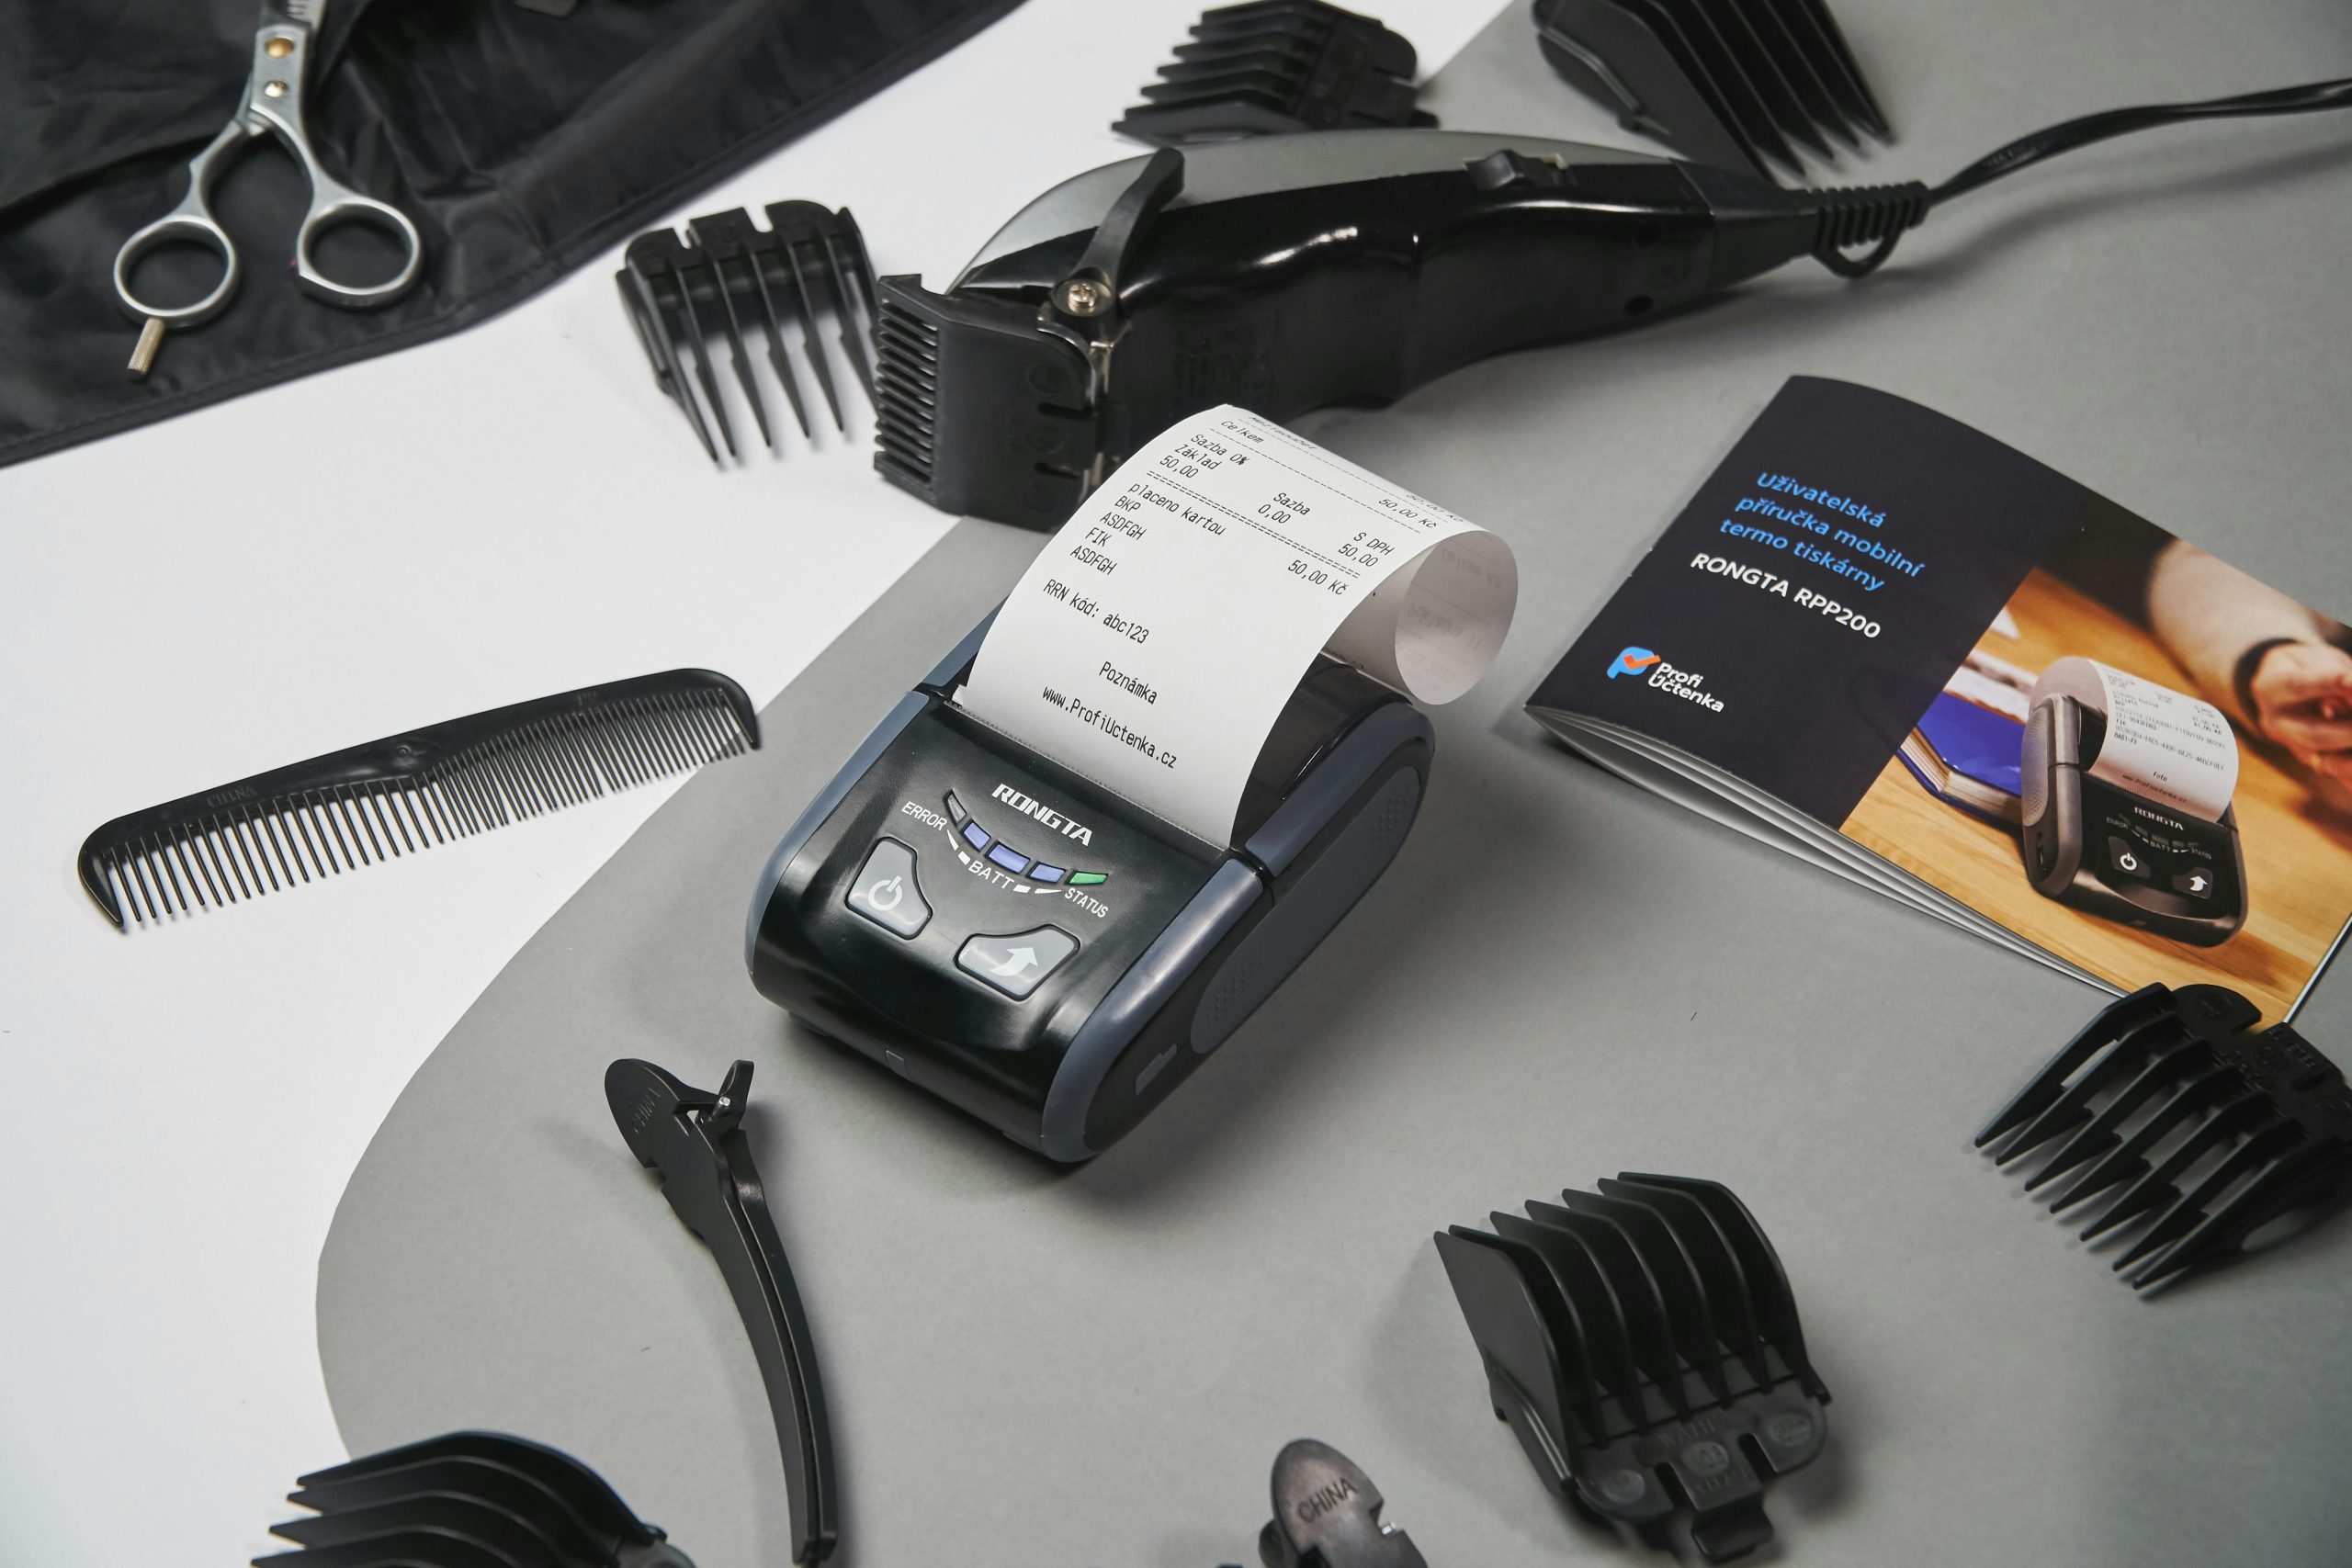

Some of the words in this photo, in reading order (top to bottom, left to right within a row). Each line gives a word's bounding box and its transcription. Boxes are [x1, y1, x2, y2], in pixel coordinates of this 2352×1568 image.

[1191, 433, 1227, 457] Sazba
[1229, 453, 1250, 466] 0%
[1220, 420, 1264, 444] Celkem
[1378, 498, 1418, 518] 50,00
[1419, 518, 1438, 528] Kč
[1114, 495, 1142, 513] BKP
[1159, 456, 1199, 479] 50,00
[1257, 503, 1292, 525] 0,00
[1338, 543, 1379, 568] 50,00
[1173, 444, 1220, 470] Základ
[1272, 492, 1311, 515] Sazba
[1353, 531, 1367, 543] S
[1365, 537, 1396, 557] DPH
[1757, 472, 1887, 528] Uživatelská
[1085, 527, 1113, 547] FIK
[1099, 512, 1148, 540] ASDFGH
[1127, 482, 1180, 513] placeno
[1181, 507, 1227, 536] kartou
[1287, 559, 1328, 585] 50,00
[1328, 579, 1349, 595] Kč
[1735, 496, 1830, 536] příručka
[1834, 528, 1927, 578] mobilní
[1070, 545, 1117, 576] ASDFGH
[1720, 518, 1788, 550] termo
[1794, 541, 1886, 592] tiskárny
[1043, 579, 1070, 602] RRN
[1069, 592, 1100, 618] kód:
[1102, 613, 1149, 644] abc123
[1690, 553, 1788, 597] RONGTA
[1793, 588, 1882, 639] RPP200
[1099, 661, 1158, 705] Poznámka
[1655, 661, 1704, 688] Profi
[1042, 686, 1178, 770] www.ProfiUctenka.cz
[900, 801, 947, 830] ERROR
[991, 784, 1093, 846] RONGTA
[967, 861, 1015, 889] BATT
[1064, 887, 1109, 919] STATUS
[1297, 1477, 1357, 1523] CHINA
